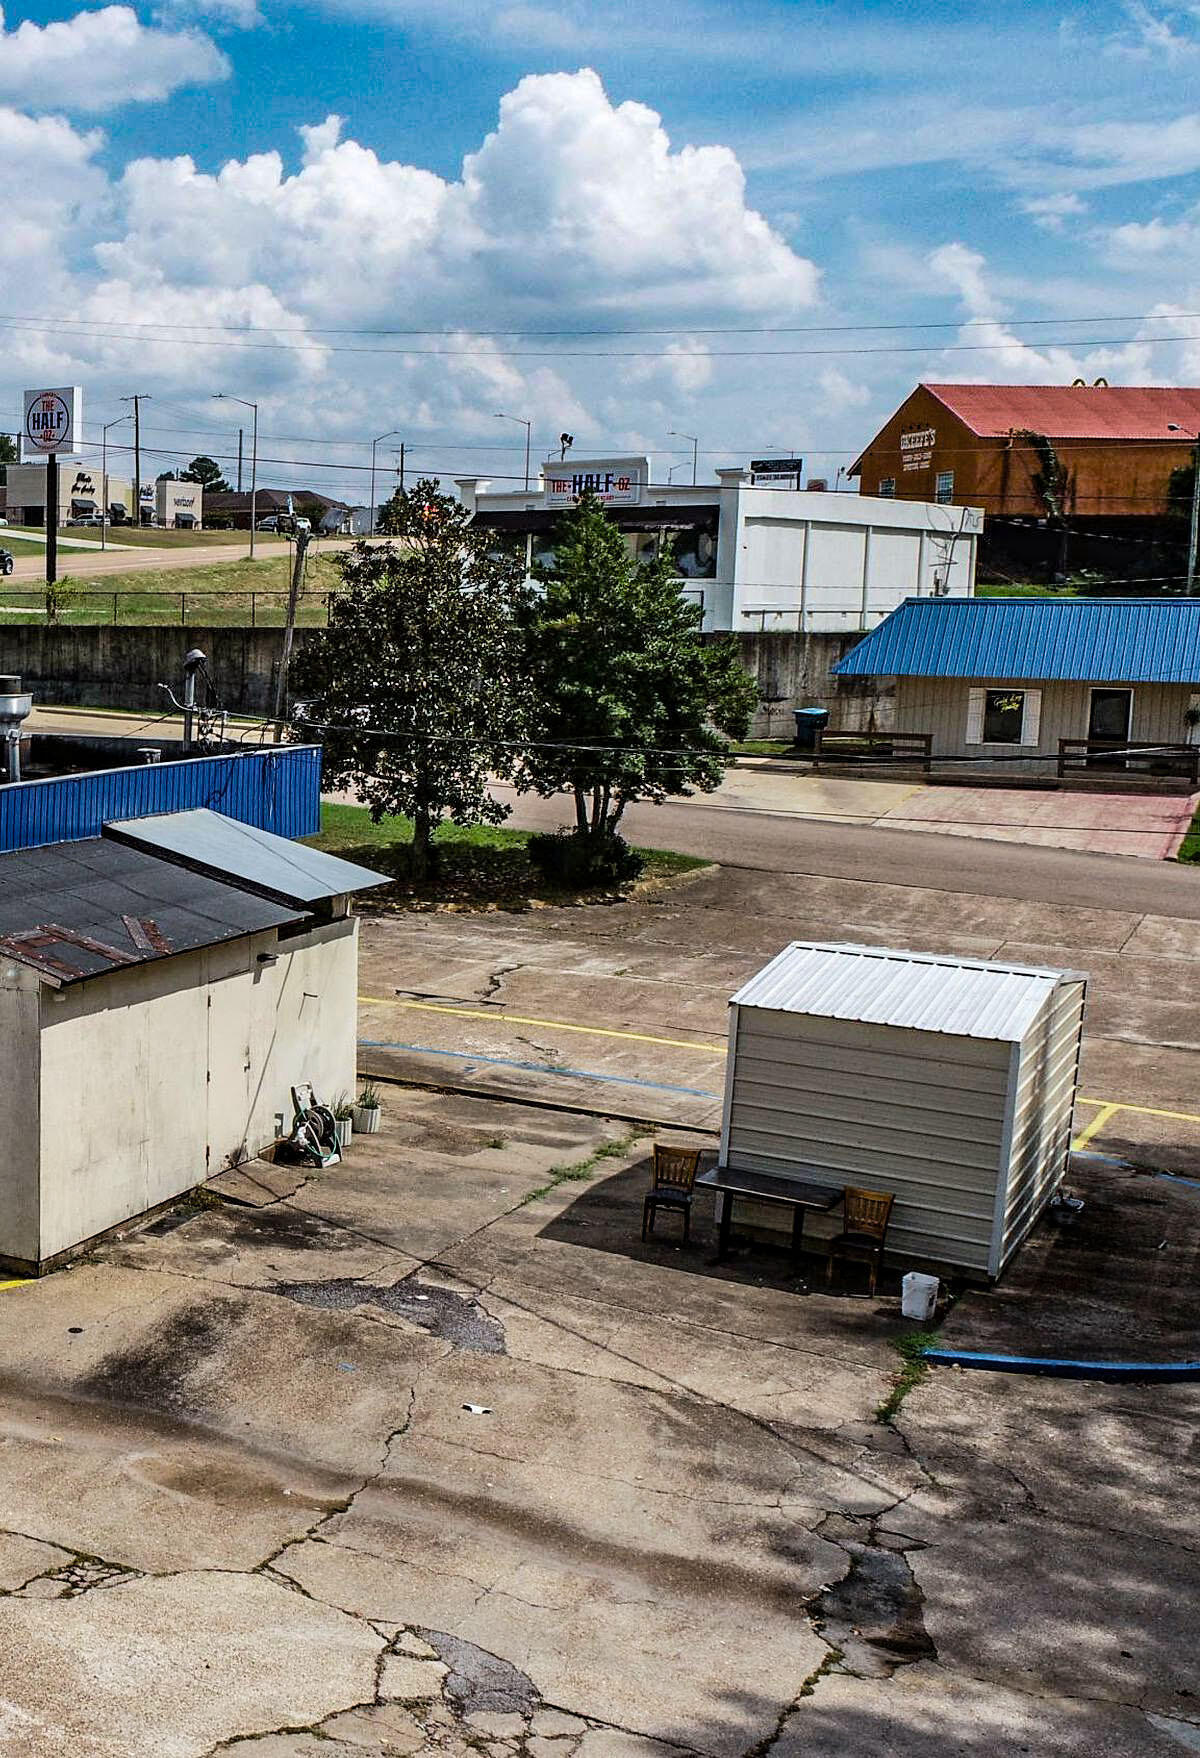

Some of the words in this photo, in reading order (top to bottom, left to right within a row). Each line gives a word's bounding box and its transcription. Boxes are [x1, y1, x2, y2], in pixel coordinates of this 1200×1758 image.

[41, 400, 55, 411] THE
[32, 411, 64, 430] HALF
[552, 480, 567, 493] THE
[572, 473, 614, 493] HALF
[618, 477, 631, 491] OZ
